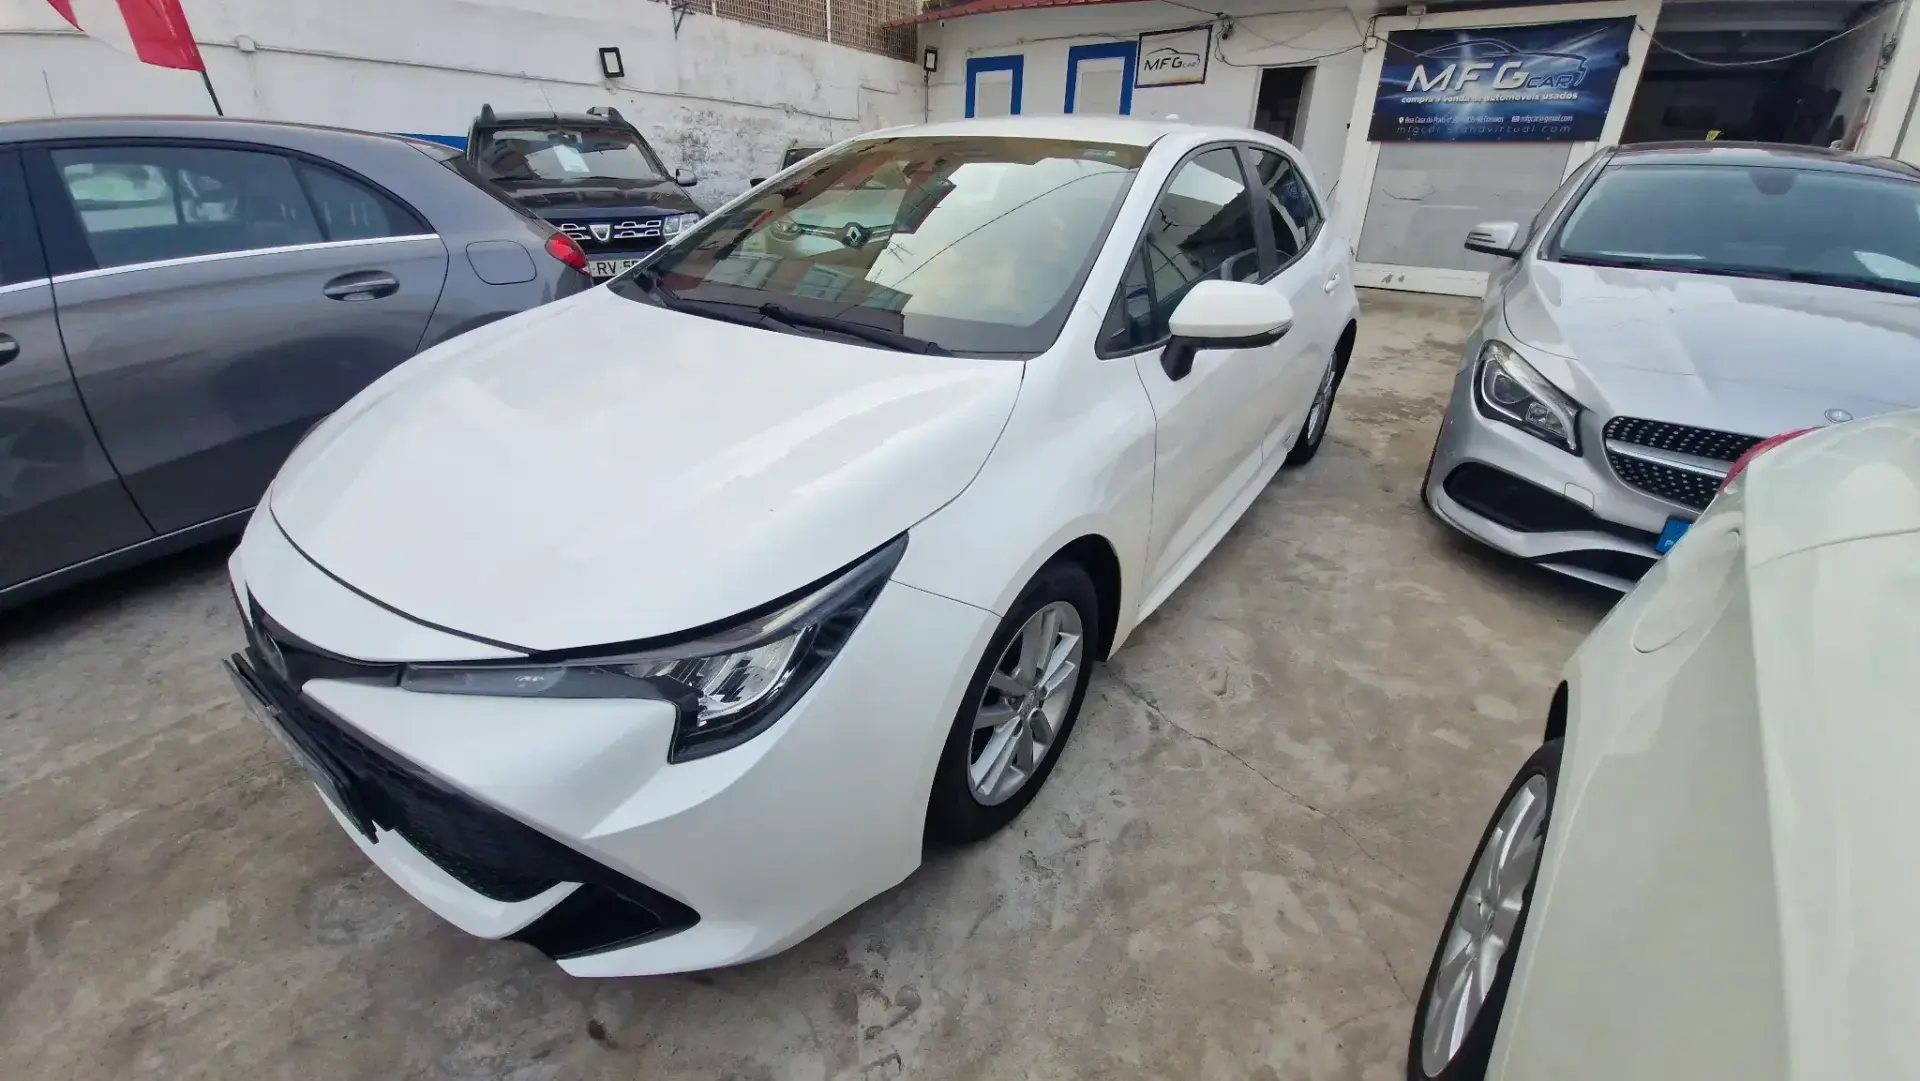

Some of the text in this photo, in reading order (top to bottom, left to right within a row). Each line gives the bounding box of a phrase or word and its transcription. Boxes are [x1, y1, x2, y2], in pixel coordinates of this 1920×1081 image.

[1144, 56, 1183, 71] MFG
[1406, 61, 1574, 92] MFG CAR
[1401, 96, 1434, 104] compra
[1542, 91, 1578, 100] usados
